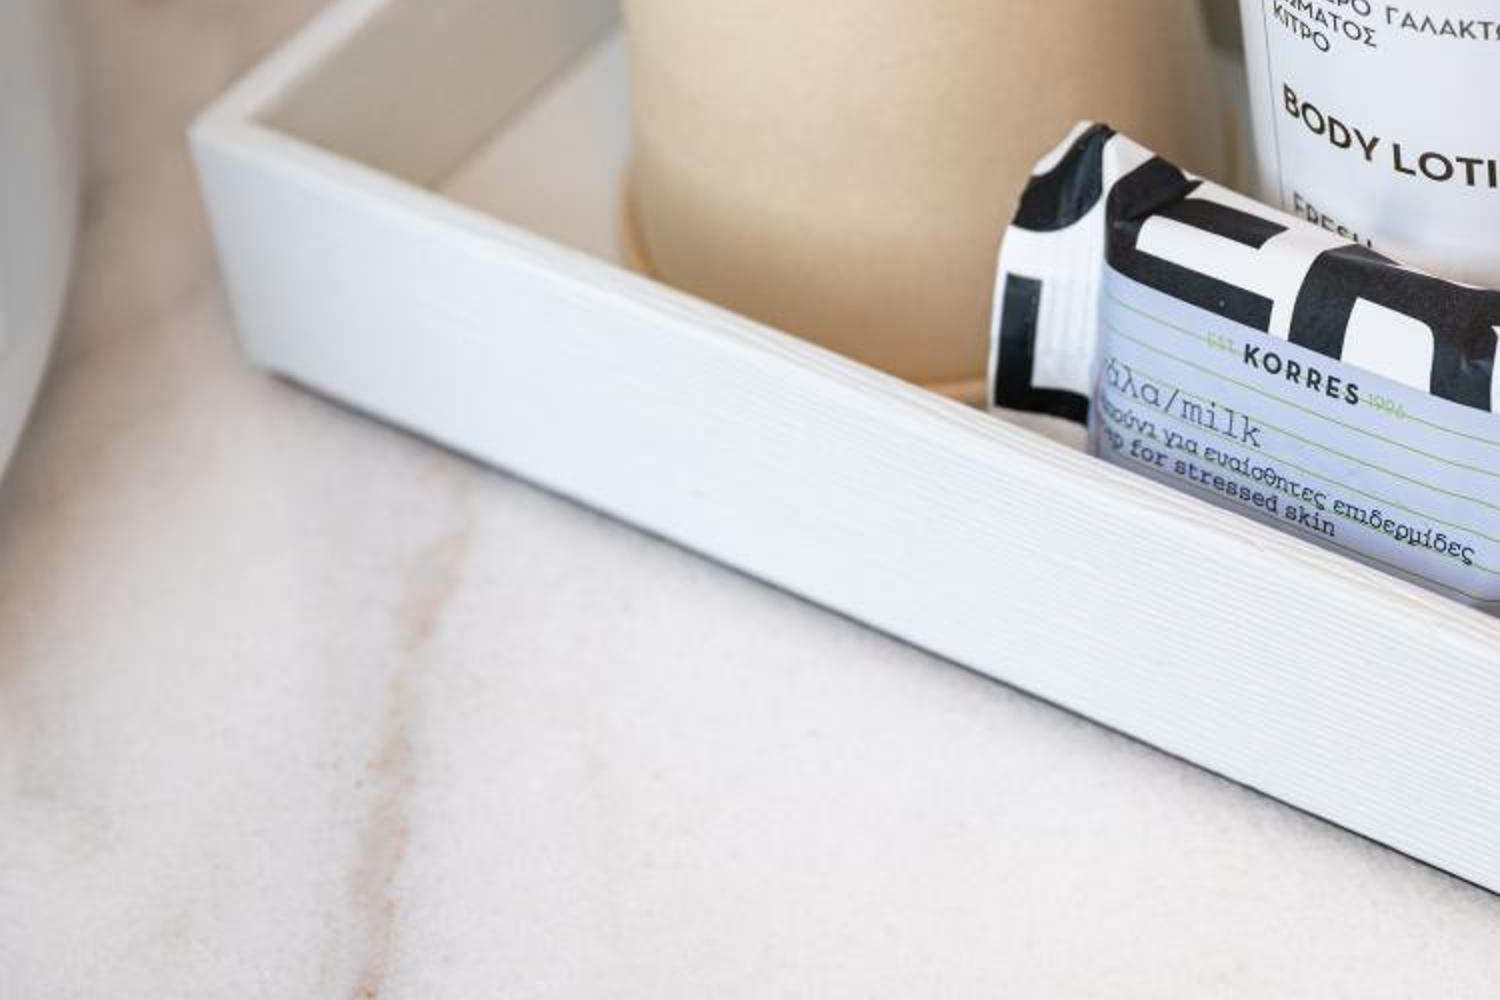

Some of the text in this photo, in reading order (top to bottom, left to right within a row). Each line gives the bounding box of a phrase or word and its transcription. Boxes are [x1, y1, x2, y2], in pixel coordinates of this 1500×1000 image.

[1272, 0, 1332, 55] ΚΙΤΡΟ
[1282, 83, 1381, 163] BODY
[1293, 191, 1372, 249] FRE
[1104, 356, 1263, 448] άλα/milk
[1242, 341, 1361, 406] KORRES
[1130, 439, 1337, 539] for stressed skin
[1163, 428, 1199, 455] για
[1203, 444, 1328, 512] ευαίσθητες
[1332, 497, 1477, 568] επιδερμίδες
